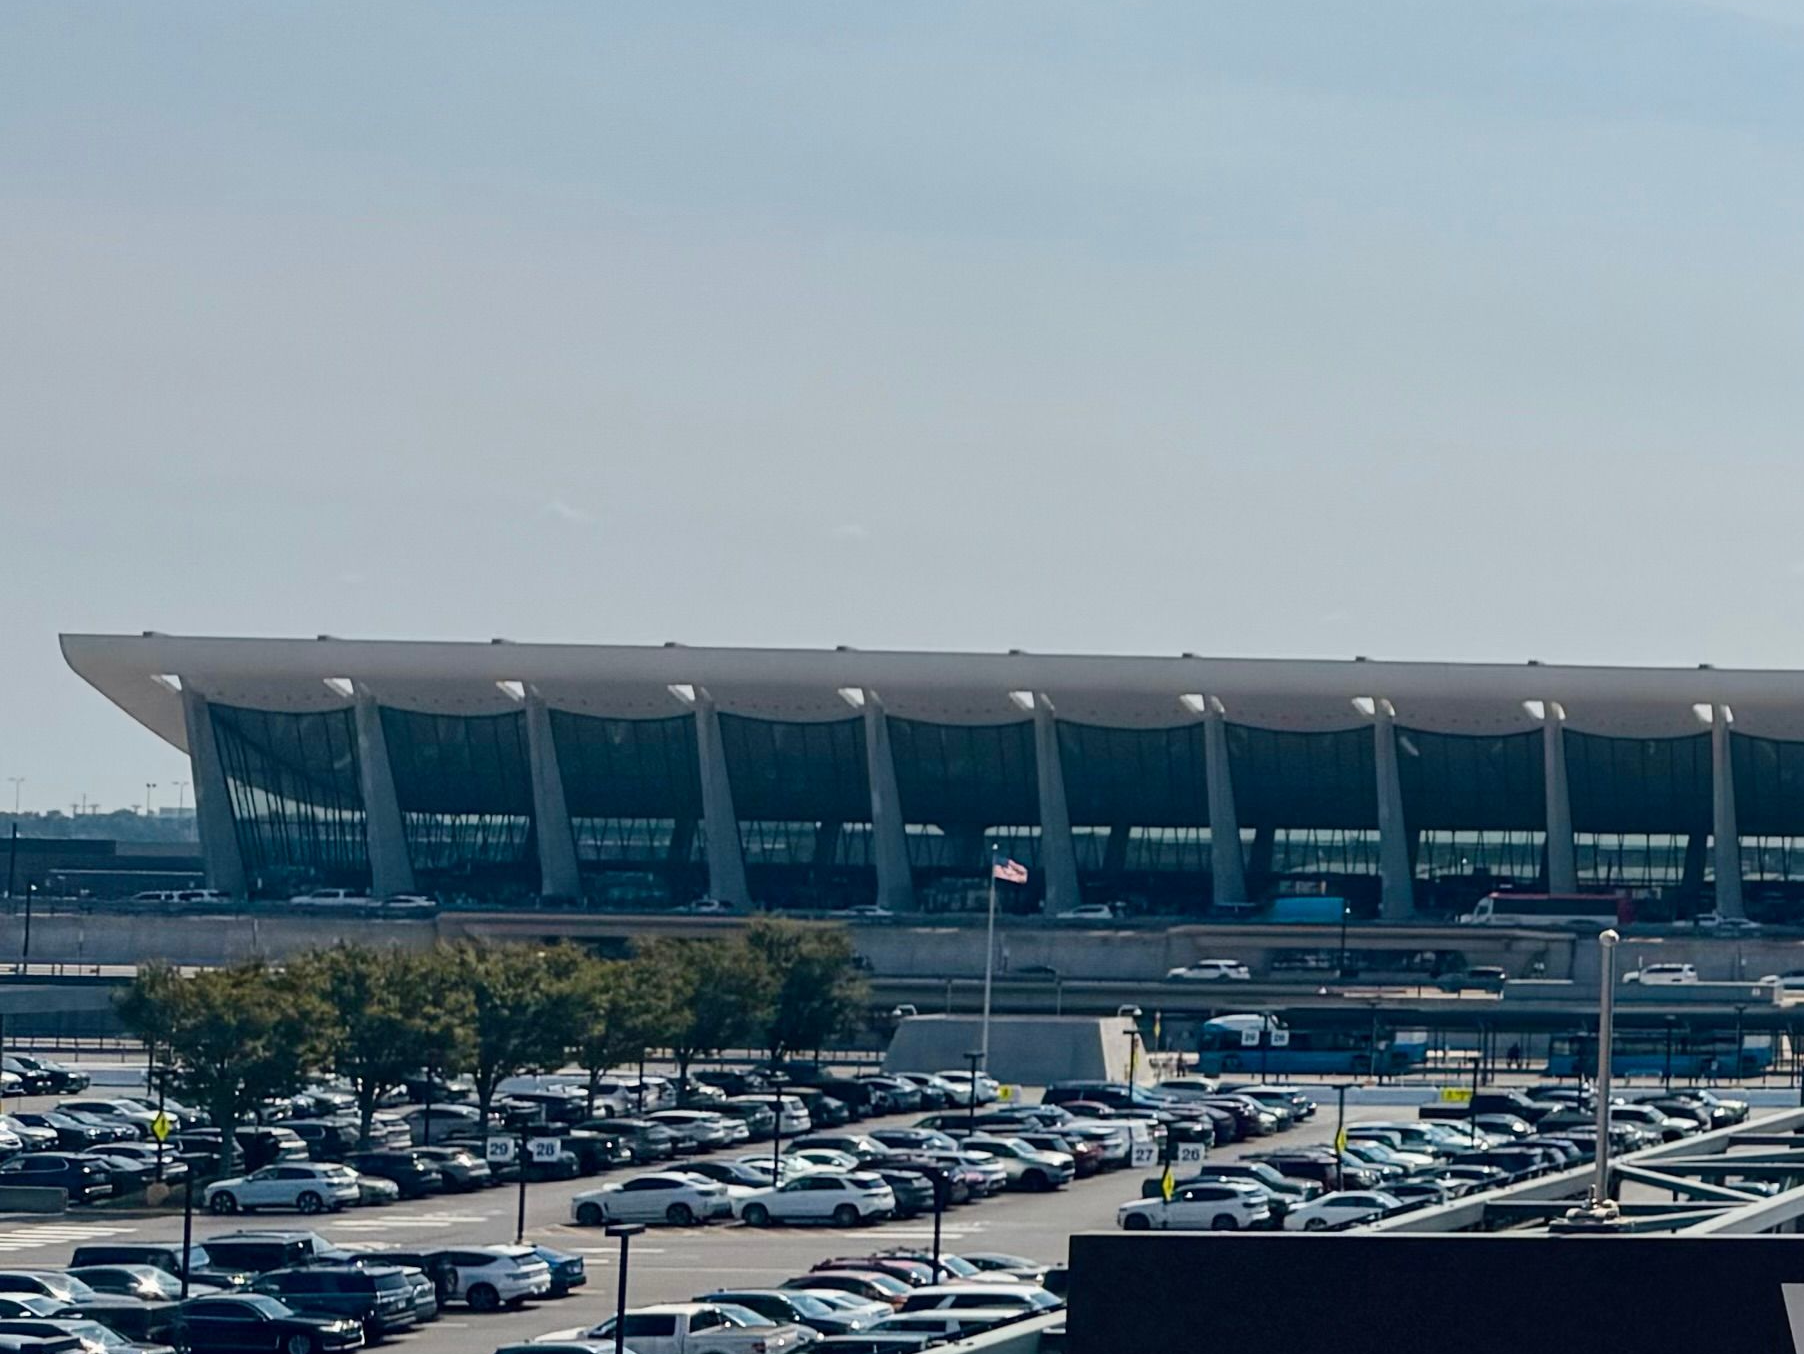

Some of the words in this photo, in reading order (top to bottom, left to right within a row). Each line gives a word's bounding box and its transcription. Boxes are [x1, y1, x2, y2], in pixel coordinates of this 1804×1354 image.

[489, 1142, 508, 1156] 29
[535, 1142, 554, 1156] 28
[1135, 1148, 1154, 1162] 27
[1181, 1148, 1200, 1162] 26
